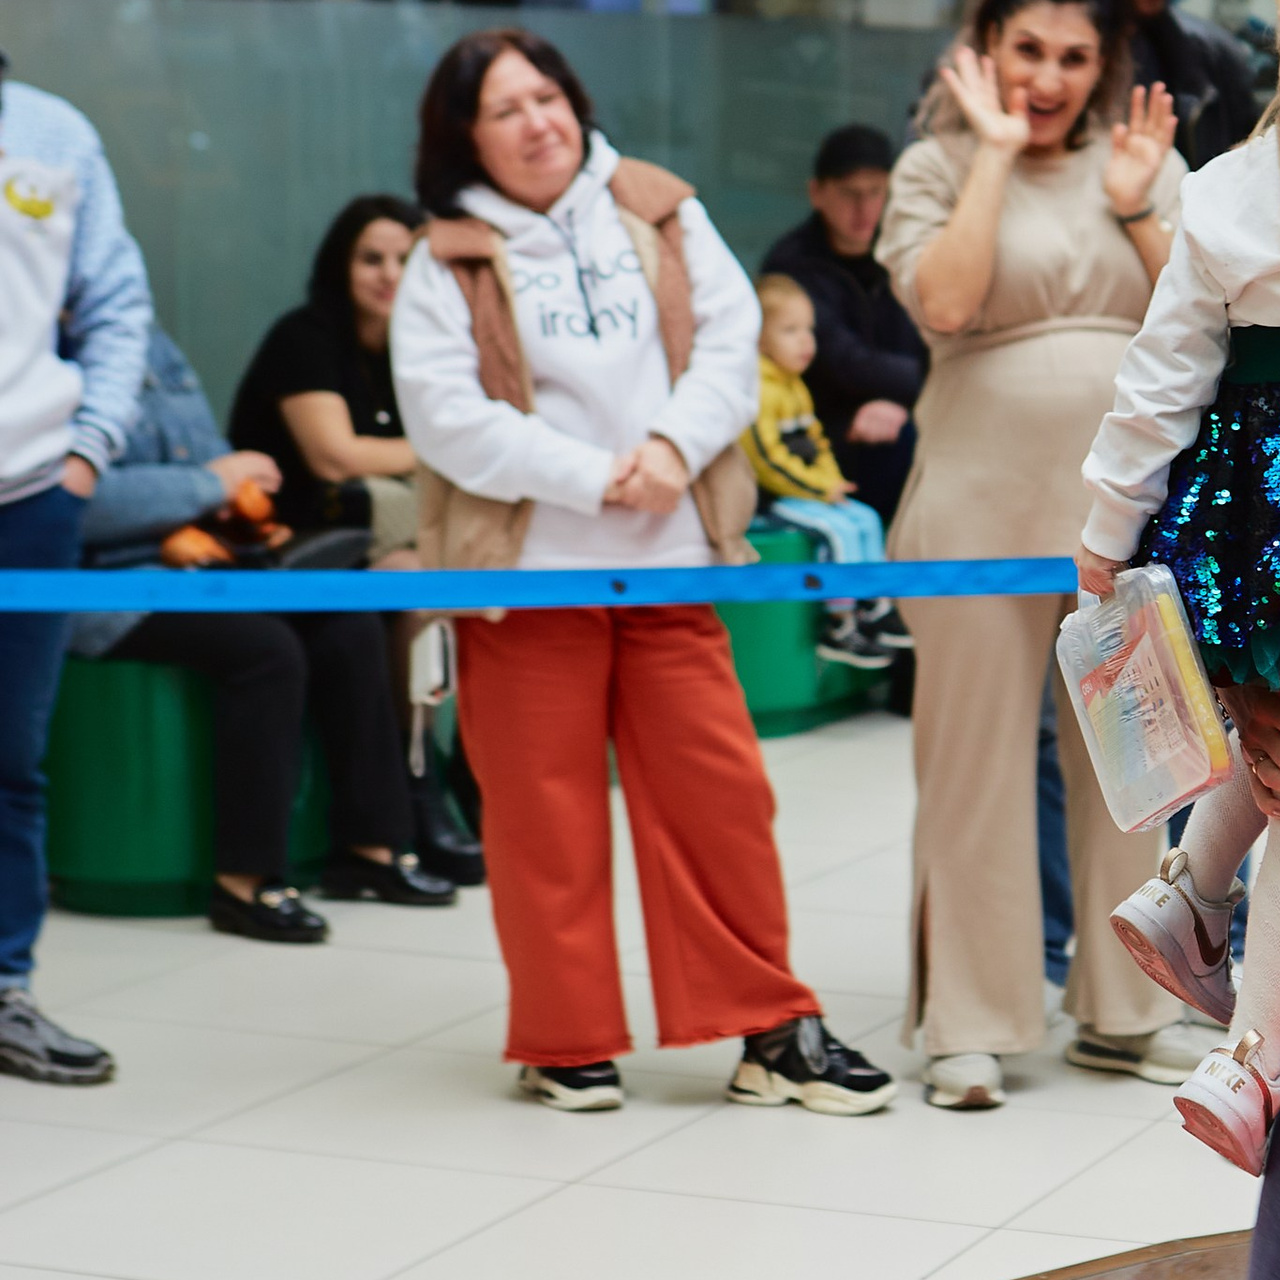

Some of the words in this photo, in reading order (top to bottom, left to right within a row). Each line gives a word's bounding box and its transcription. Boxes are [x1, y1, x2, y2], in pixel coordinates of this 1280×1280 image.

[538, 297, 638, 339] irony
[1138, 884, 1170, 908] NIKE
[1205, 1061, 1246, 1094] NIKE
